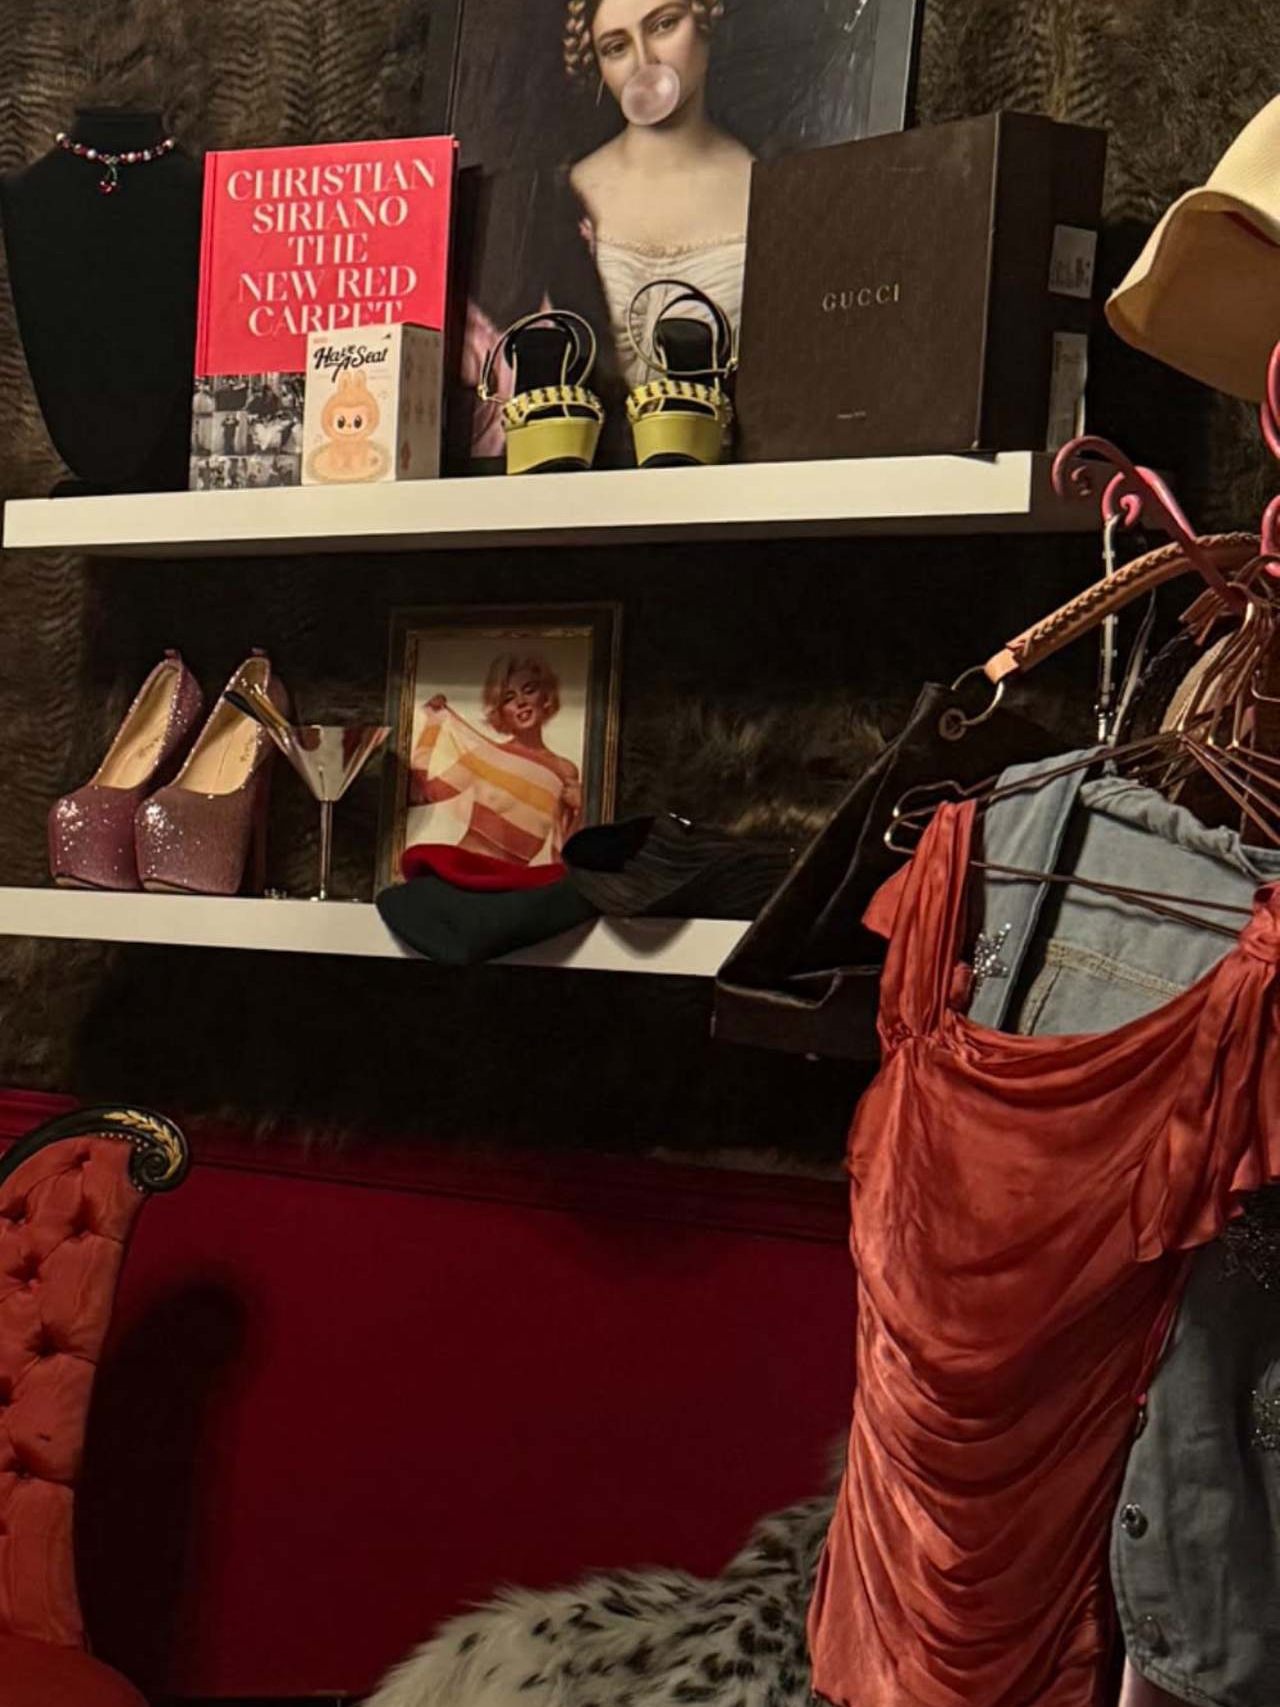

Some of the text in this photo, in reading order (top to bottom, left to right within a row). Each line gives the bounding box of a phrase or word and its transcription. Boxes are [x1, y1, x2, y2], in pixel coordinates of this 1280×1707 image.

[227, 159, 436, 200] CHRISTIAN
[252, 196, 409, 234] SIRIANO
[288, 233, 368, 266] THE
[240, 265, 418, 303] NEW RED
[822, 283, 900, 312] GUCCI
[248, 302, 403, 337] CARPET
[313, 344, 356, 369] Have
[351, 345, 388, 368] Seat
